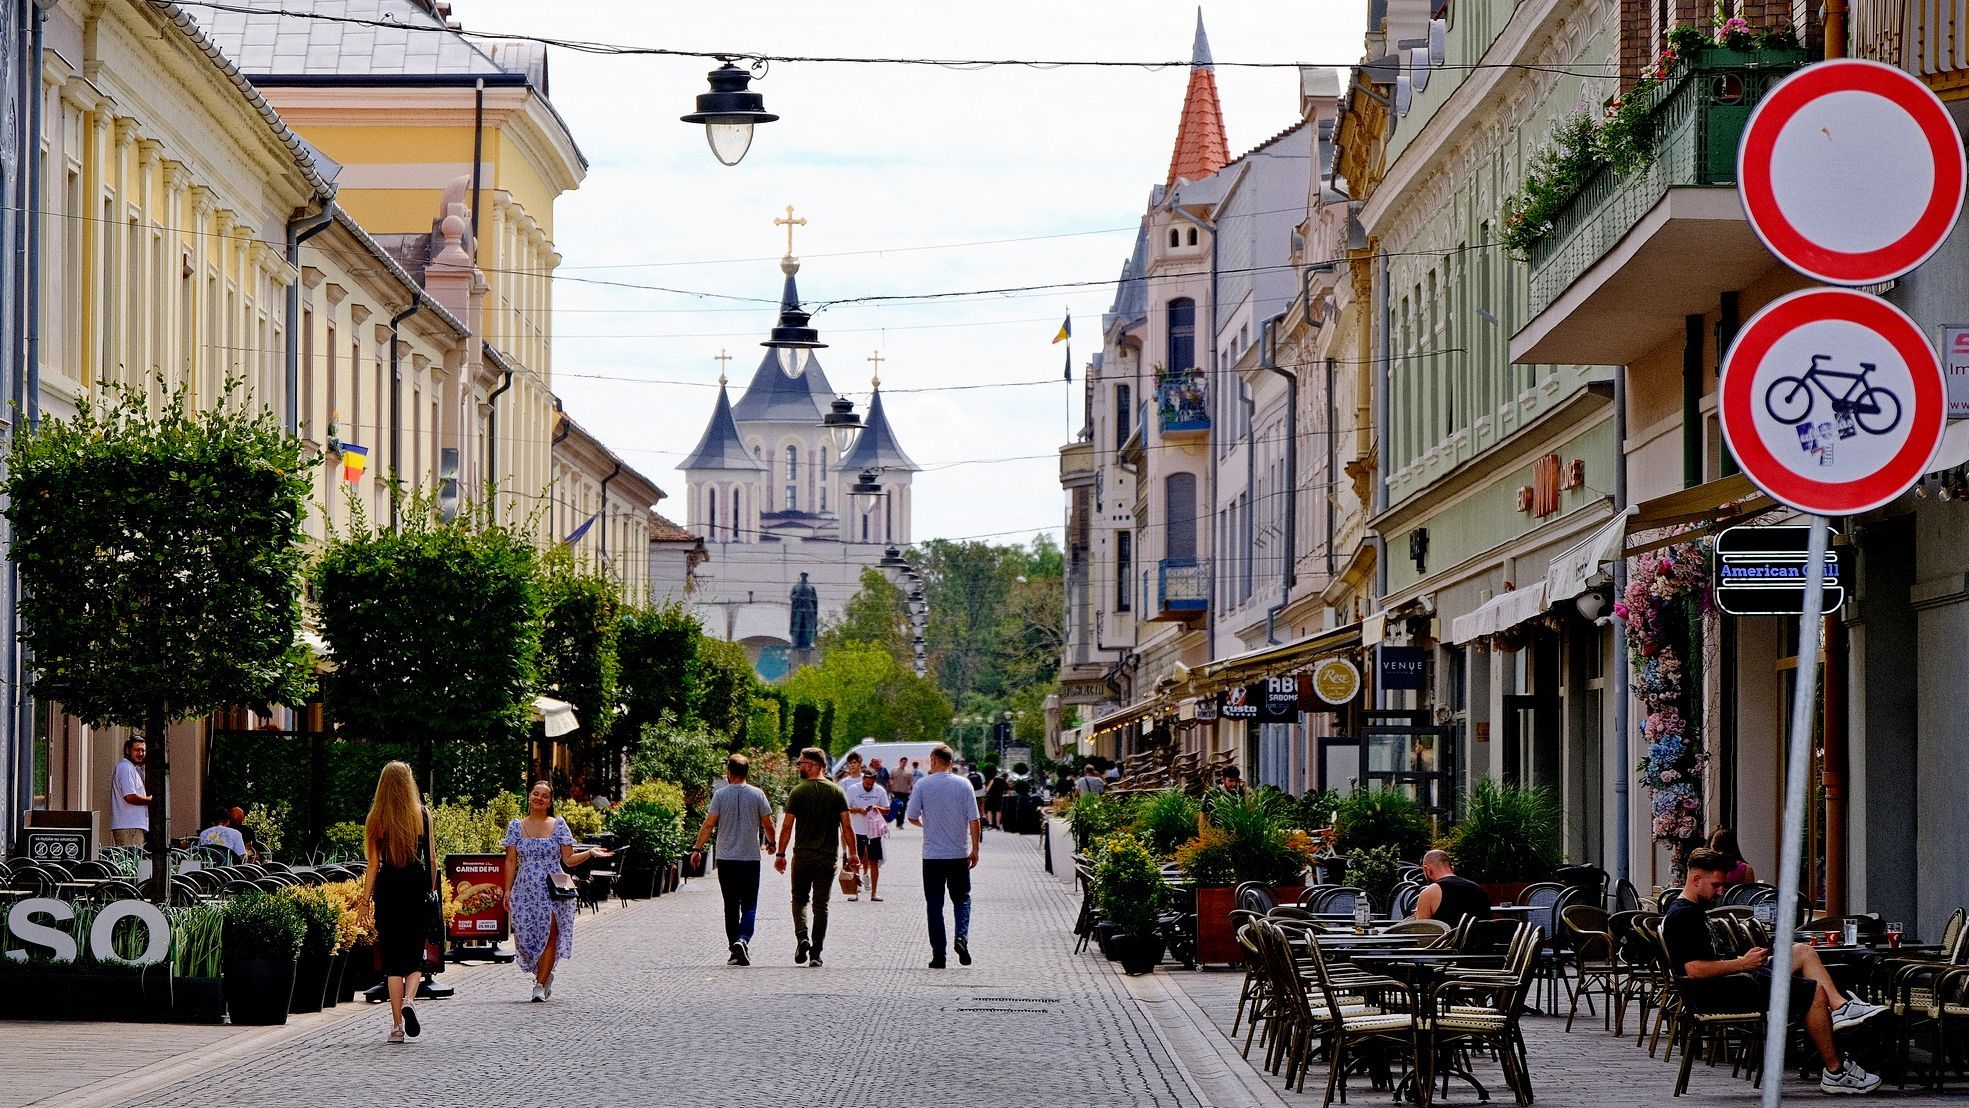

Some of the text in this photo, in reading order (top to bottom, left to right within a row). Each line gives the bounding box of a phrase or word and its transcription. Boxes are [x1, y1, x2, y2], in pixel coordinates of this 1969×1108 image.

[1720, 563, 1799, 577] American
[1383, 661, 1422, 671] VENUE
[1268, 677, 1298, 693] AB
[5, 897, 170, 966] SO
